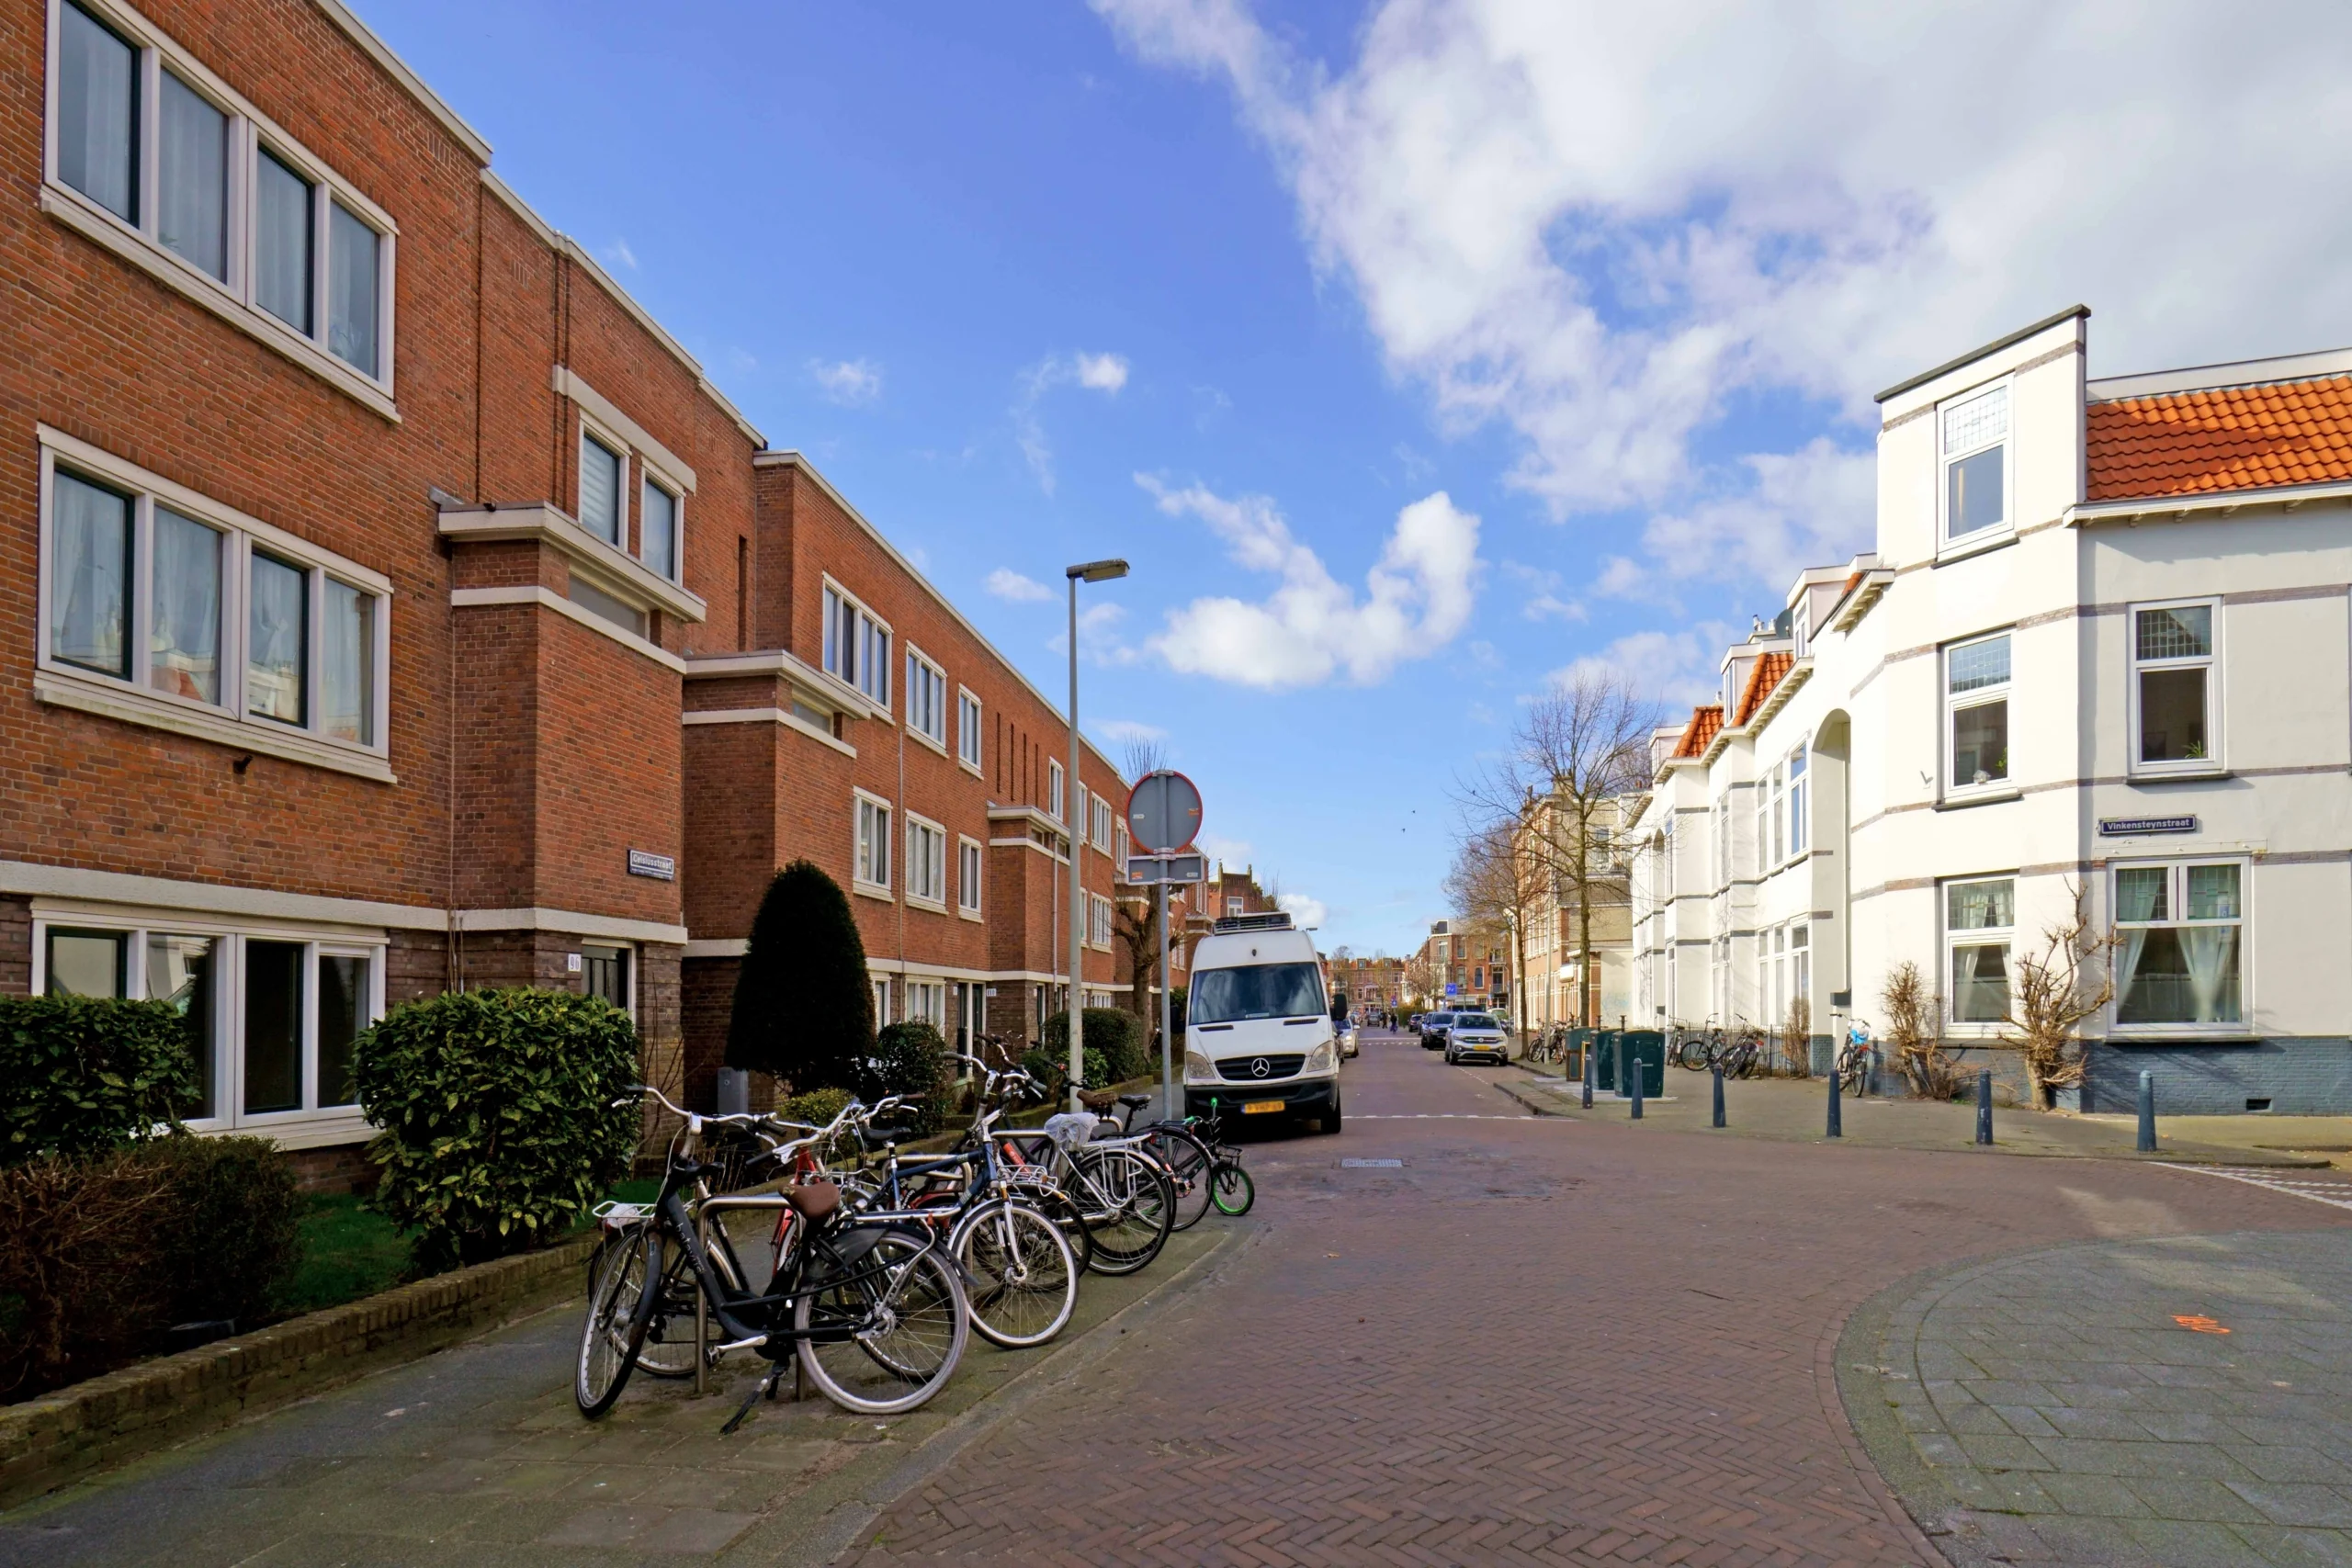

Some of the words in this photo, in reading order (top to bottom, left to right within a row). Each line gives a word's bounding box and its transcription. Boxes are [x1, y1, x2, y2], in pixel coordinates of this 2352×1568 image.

[2108, 818, 2190, 830] Vinkensteynstraat
[632, 854, 672, 870] Celsiusstraat
[570, 956, 580, 970] 96
